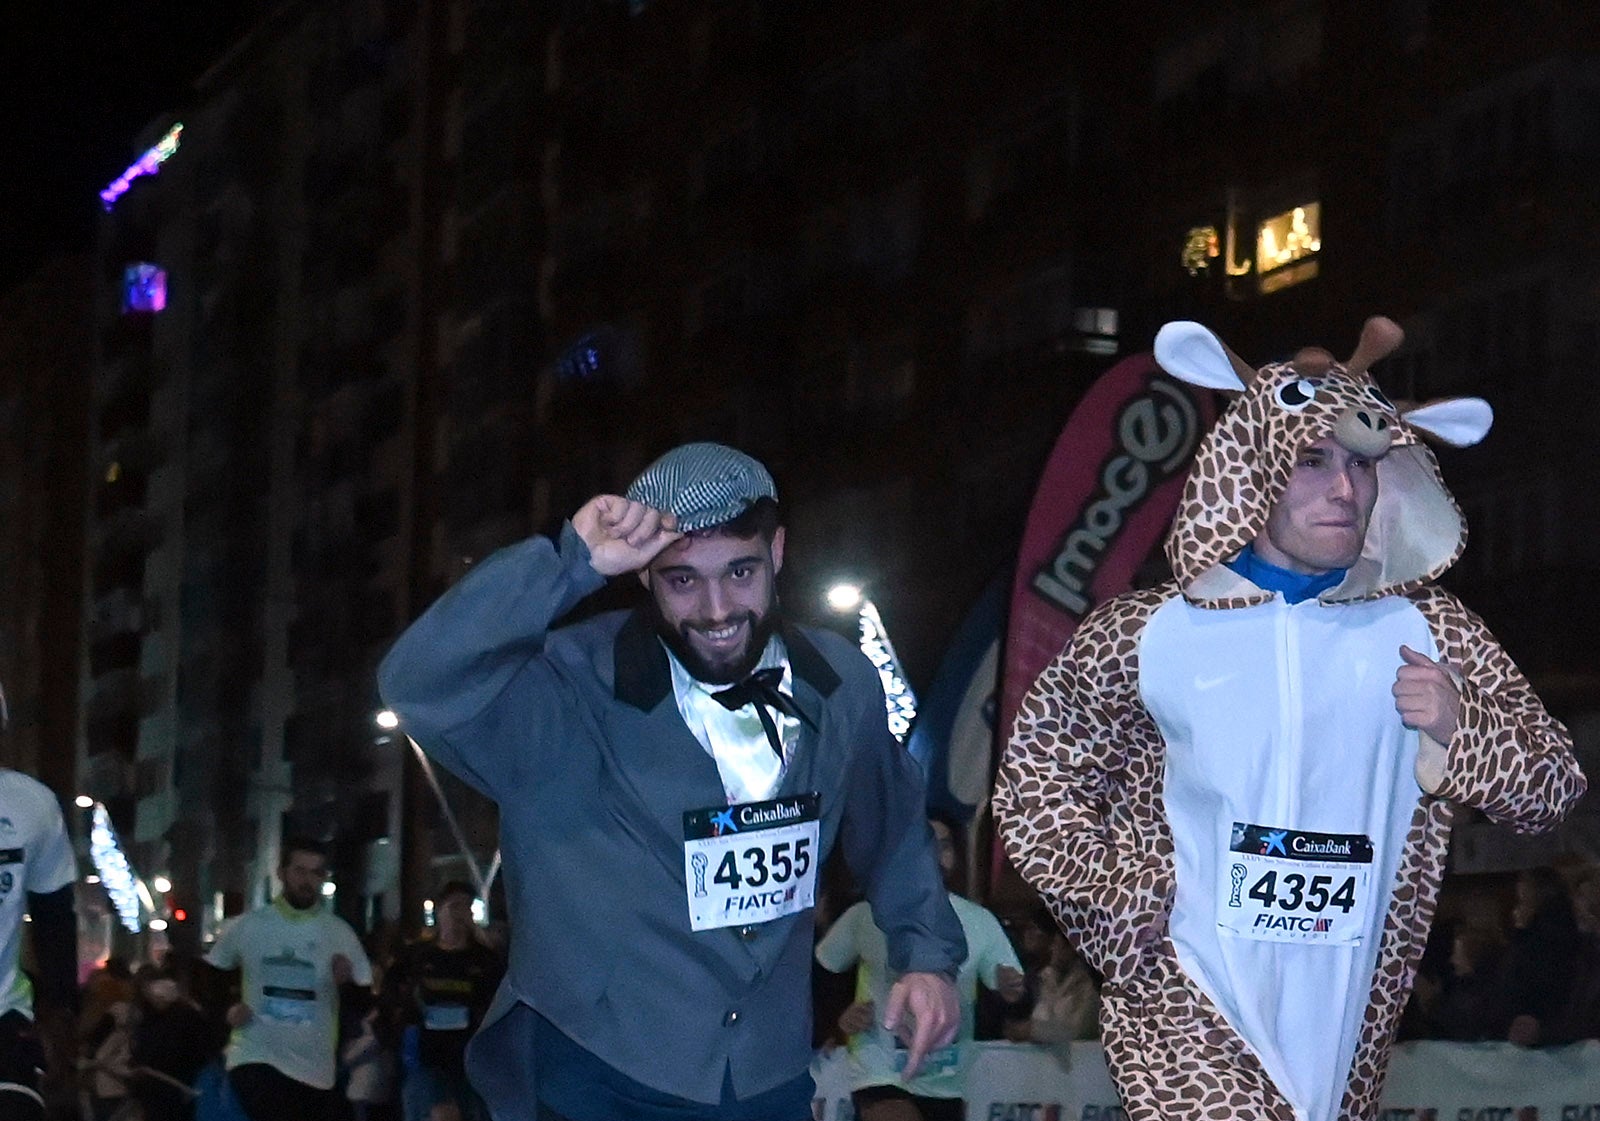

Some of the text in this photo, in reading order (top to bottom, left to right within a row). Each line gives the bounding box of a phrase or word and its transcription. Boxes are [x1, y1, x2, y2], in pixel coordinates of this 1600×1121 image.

[740, 801, 802, 825] CaixaBank
[1292, 836, 1352, 855] CaixaBank
[713, 838, 811, 889] 4355
[725, 890, 784, 912] FIATC
[1249, 870, 1356, 914] 4354
[1253, 913, 1314, 932] FIATC
